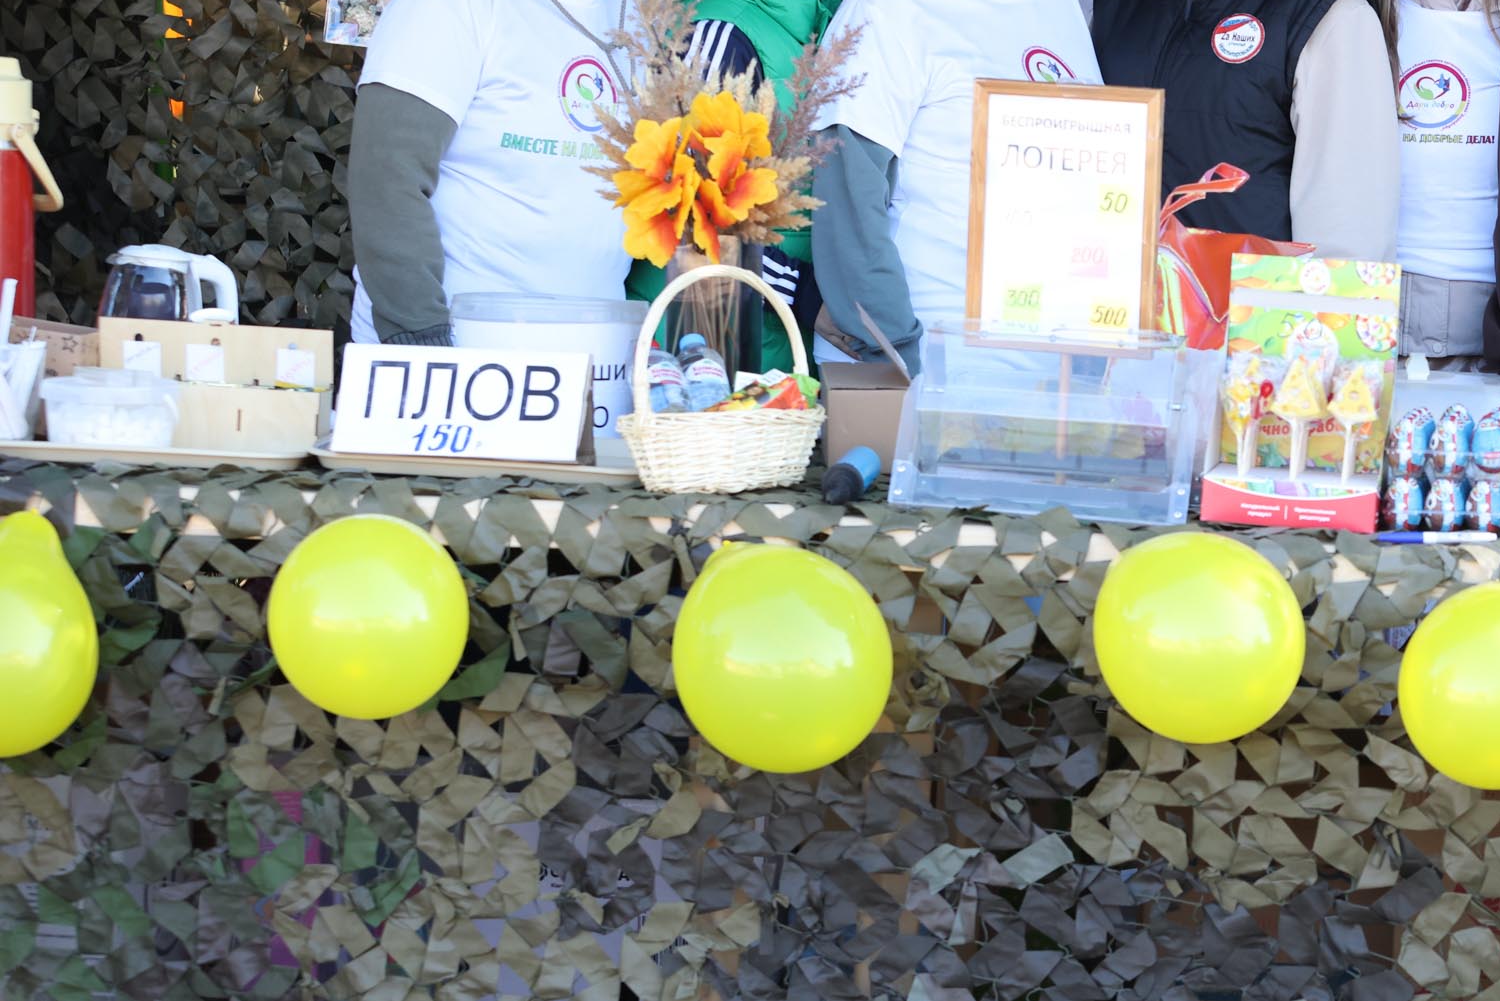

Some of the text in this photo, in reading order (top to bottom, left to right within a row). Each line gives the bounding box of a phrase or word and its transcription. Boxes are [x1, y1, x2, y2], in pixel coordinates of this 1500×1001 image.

[1001, 114, 1132, 135] БЕСПРОИГРЫШНАЯ
[500, 132, 558, 155] ВМЕСТЕ
[1419, 133, 1464, 145] ДОБРЫЕ
[1466, 135, 1496, 145] ДЕЛА!
[1001, 144, 1127, 175] ЛОТЕРЕЯ
[1099, 192, 1128, 214] 50
[1092, 305, 1128, 327] 500
[364, 360, 560, 423] ПЛОВ
[411, 423, 474, 454] 150
